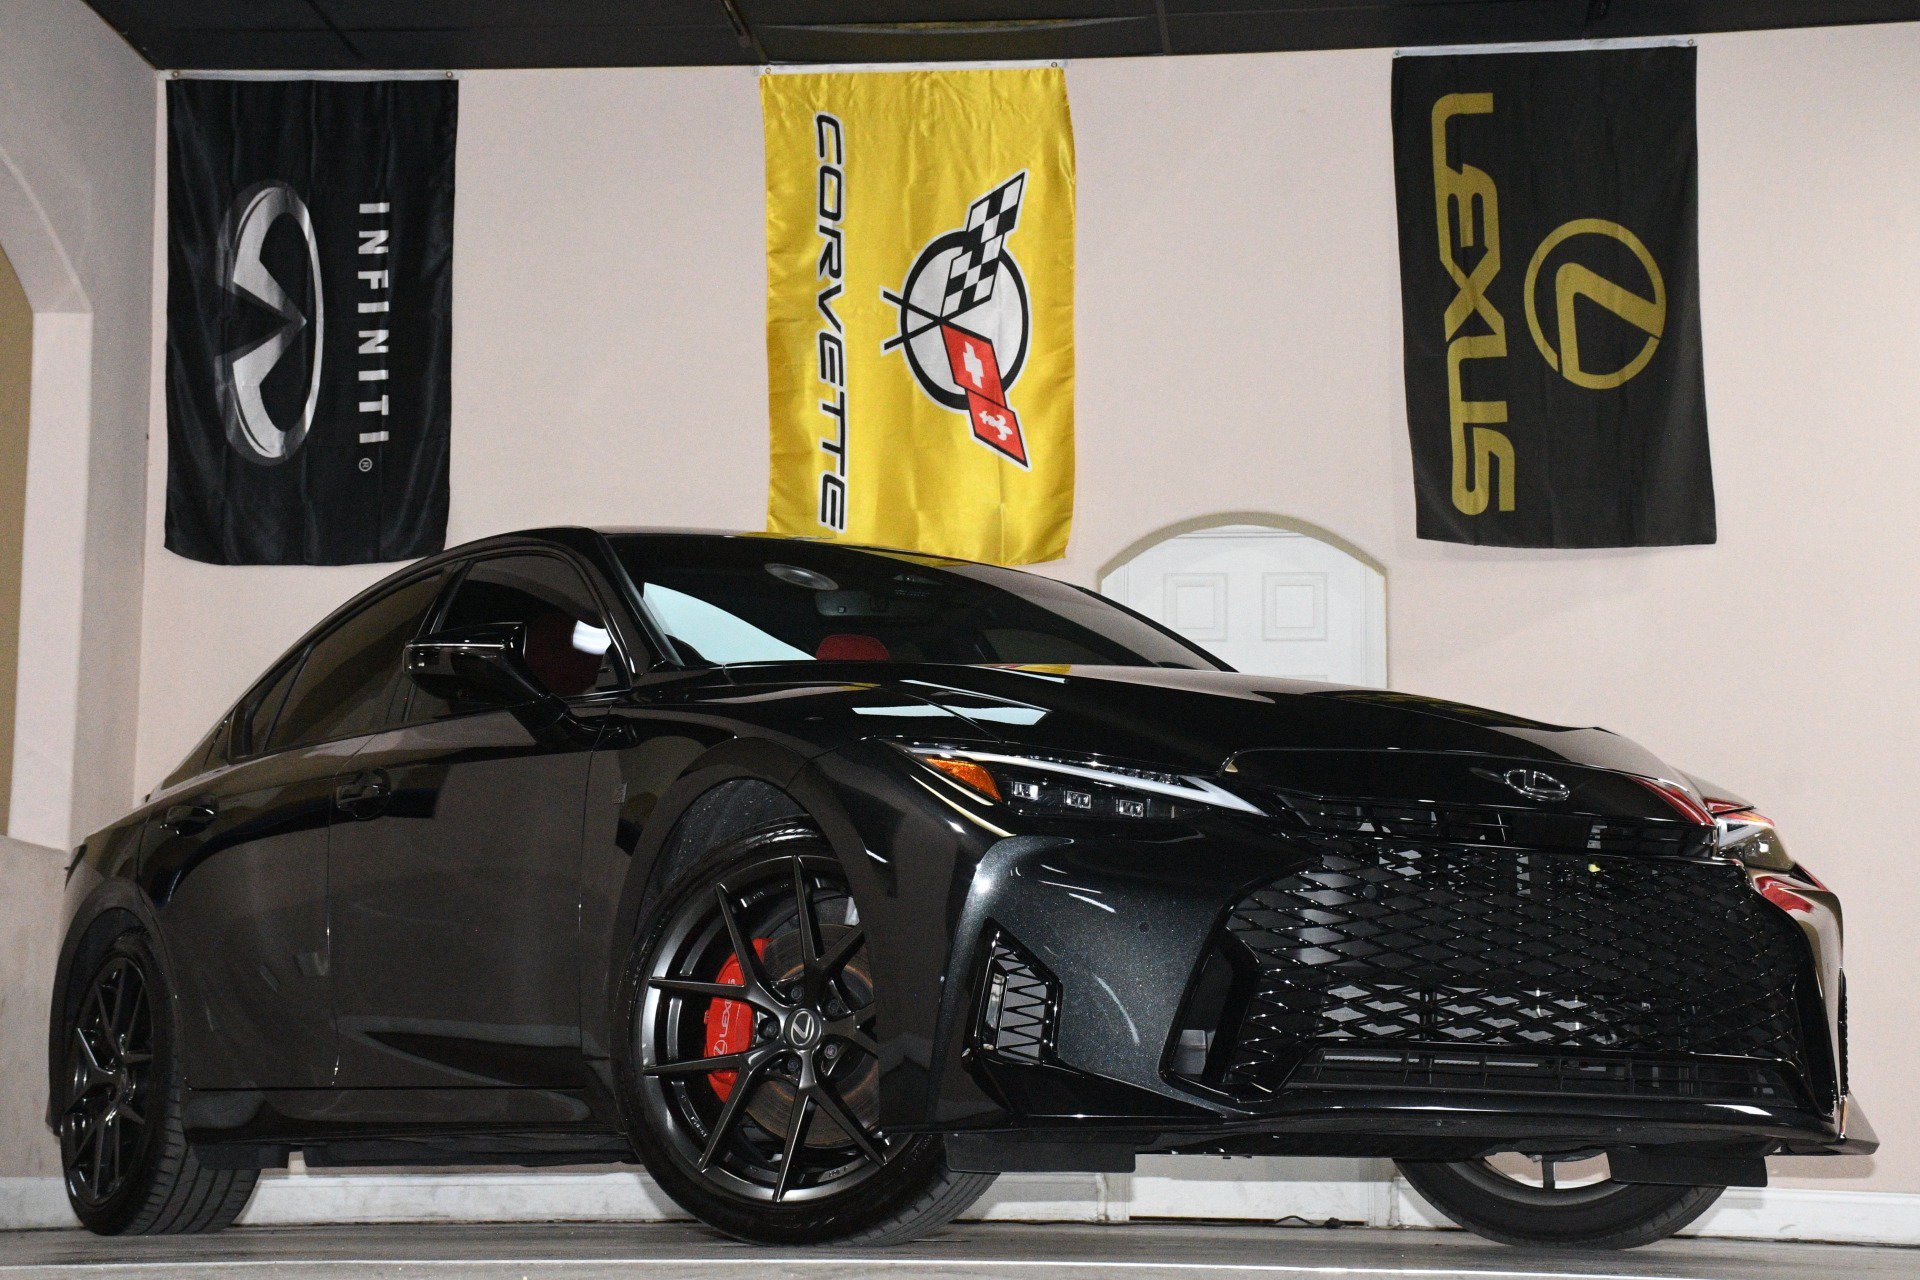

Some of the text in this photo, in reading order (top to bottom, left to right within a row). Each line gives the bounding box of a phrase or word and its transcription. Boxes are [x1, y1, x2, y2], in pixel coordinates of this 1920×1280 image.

[357, 202, 390, 444] INFINITI
[814, 111, 848, 533] CORVETTE
[1431, 91, 1516, 516] LEXUS
[719, 978, 736, 1038] LEXS
